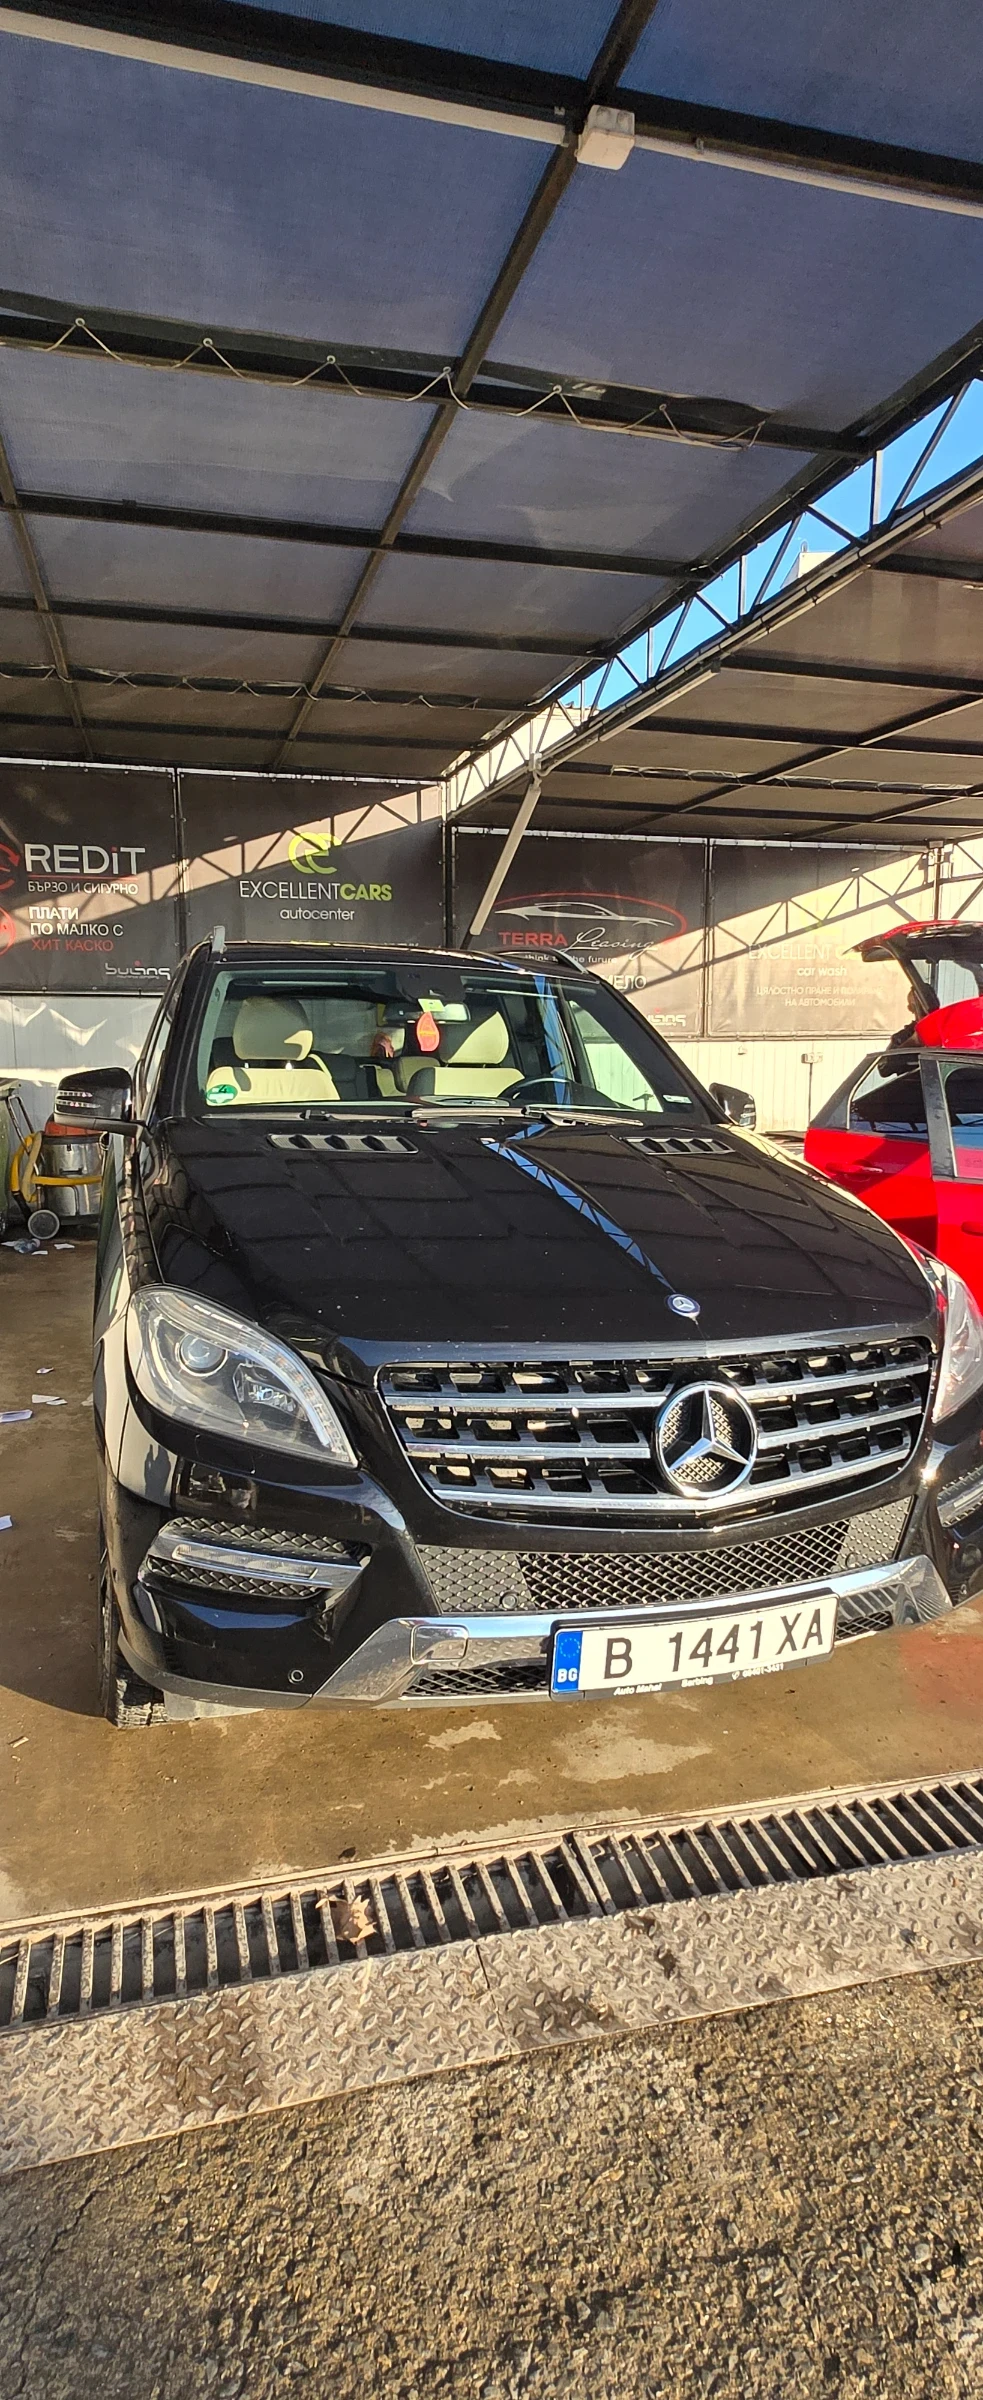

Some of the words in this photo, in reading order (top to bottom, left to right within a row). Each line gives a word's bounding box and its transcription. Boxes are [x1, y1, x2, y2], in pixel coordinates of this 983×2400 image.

[28, 881, 68, 893] БЪРЗО
[71, 882, 81, 893] И
[83, 882, 139, 895] СИГУРНО
[29, 906, 79, 920] ПЛАТИ
[280, 907, 355, 920] autocenter
[30, 922, 53, 936] ПО
[57, 923, 109, 936] МАЛКО
[112, 924, 124, 936] С
[32, 939, 61, 951] ХИТ
[65, 939, 114, 951] КАСКО
[499, 932, 568, 947] TERRA
[560, 926, 659, 961] Leasing
[748, 943, 833, 960] EXCELLENT
[797, 967, 815, 976] car
[818, 965, 847, 976] wash
[756, 987, 803, 996] ЦЯЛОСТНО
[805, 986, 831, 995] ПРАНЕ
[785, 998, 797, 1006] НА
[798, 998, 856, 1007] АВТОМОБИЛИ
[218, 1084, 227, 1094] 4
[603, 1637, 633, 1680] B
[668, 1619, 764, 1673] 1441
[775, 1608, 824, 1656] XA
[557, 1667, 578, 1683] BG
[613, 1686, 634, 1696] Auto
